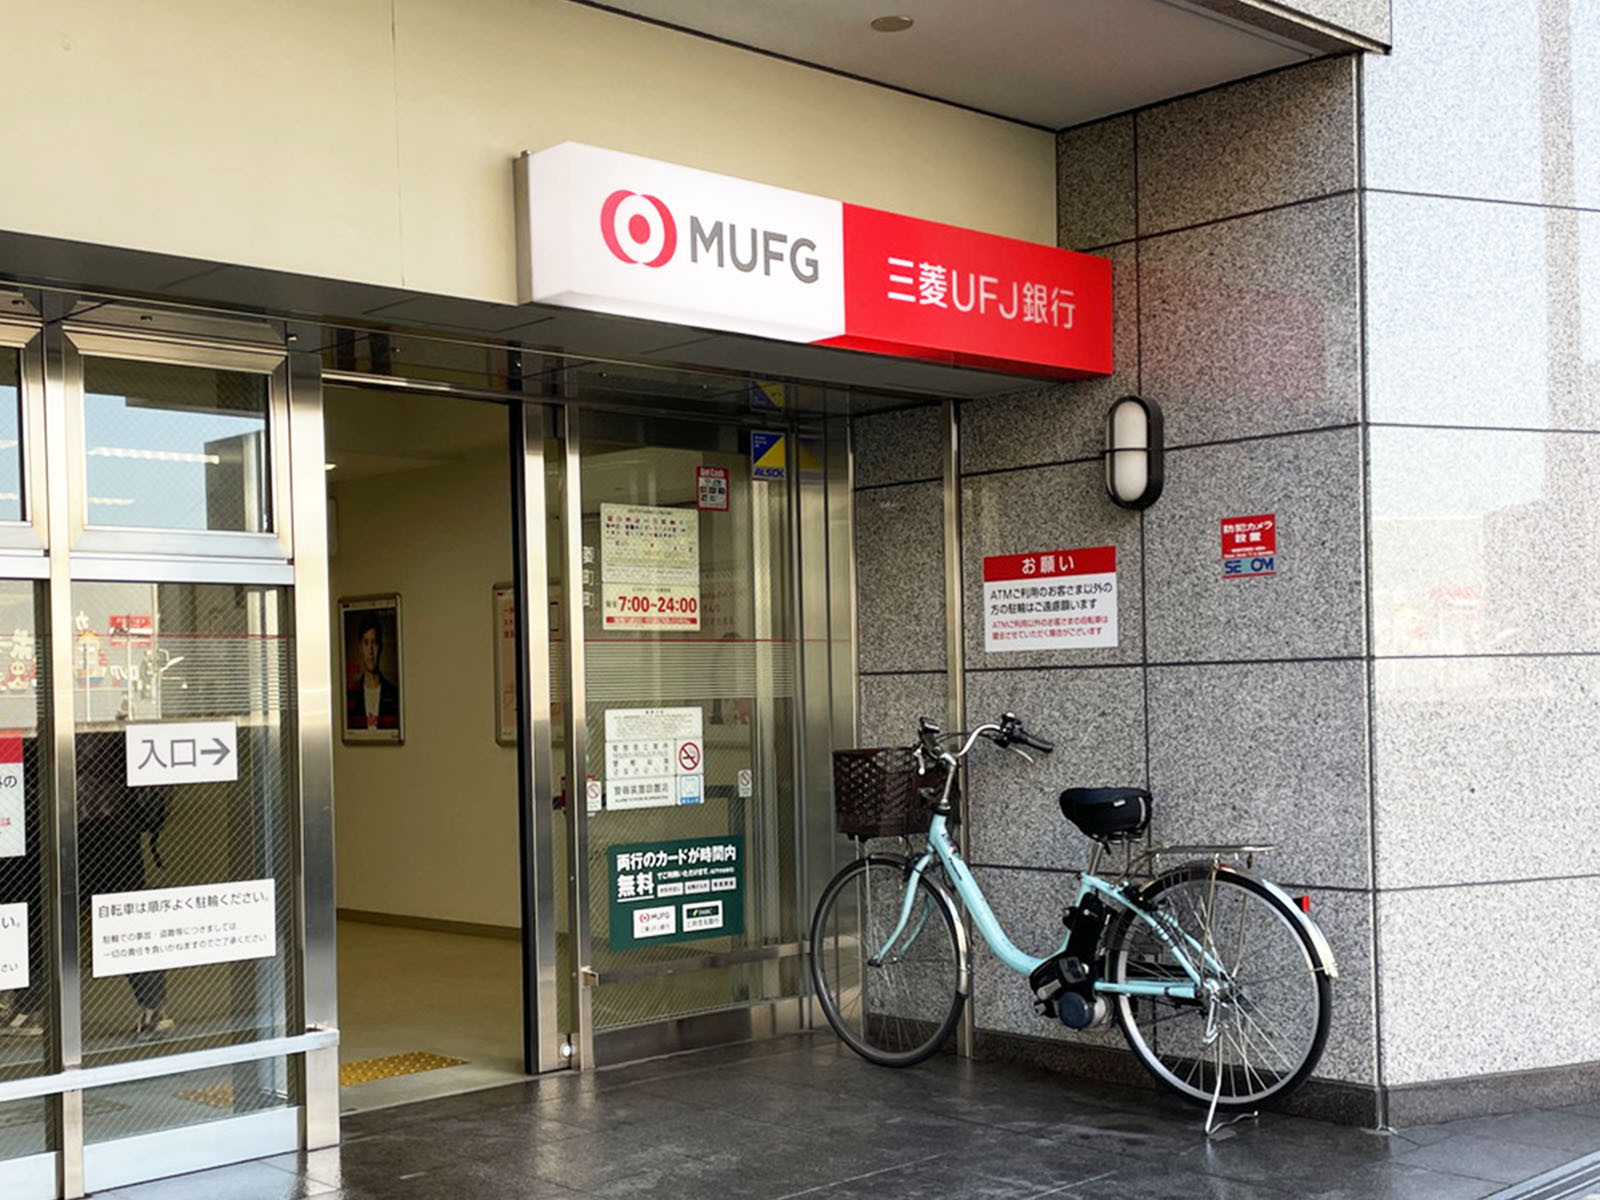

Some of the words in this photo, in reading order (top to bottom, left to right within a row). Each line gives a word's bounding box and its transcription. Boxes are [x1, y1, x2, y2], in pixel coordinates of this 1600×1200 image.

[690, 215, 819, 284] MUFG
[888, 257, 1077, 330] 三菱UFJ銀行
[1021, 554, 1075, 575] お願い
[137, 738, 197, 770] 入口
[616, 844, 737, 872] 両行のカードが時間内
[617, 871, 655, 898] 無料
[98, 891, 269, 919] 自転車は順序よく駐輪ください。
